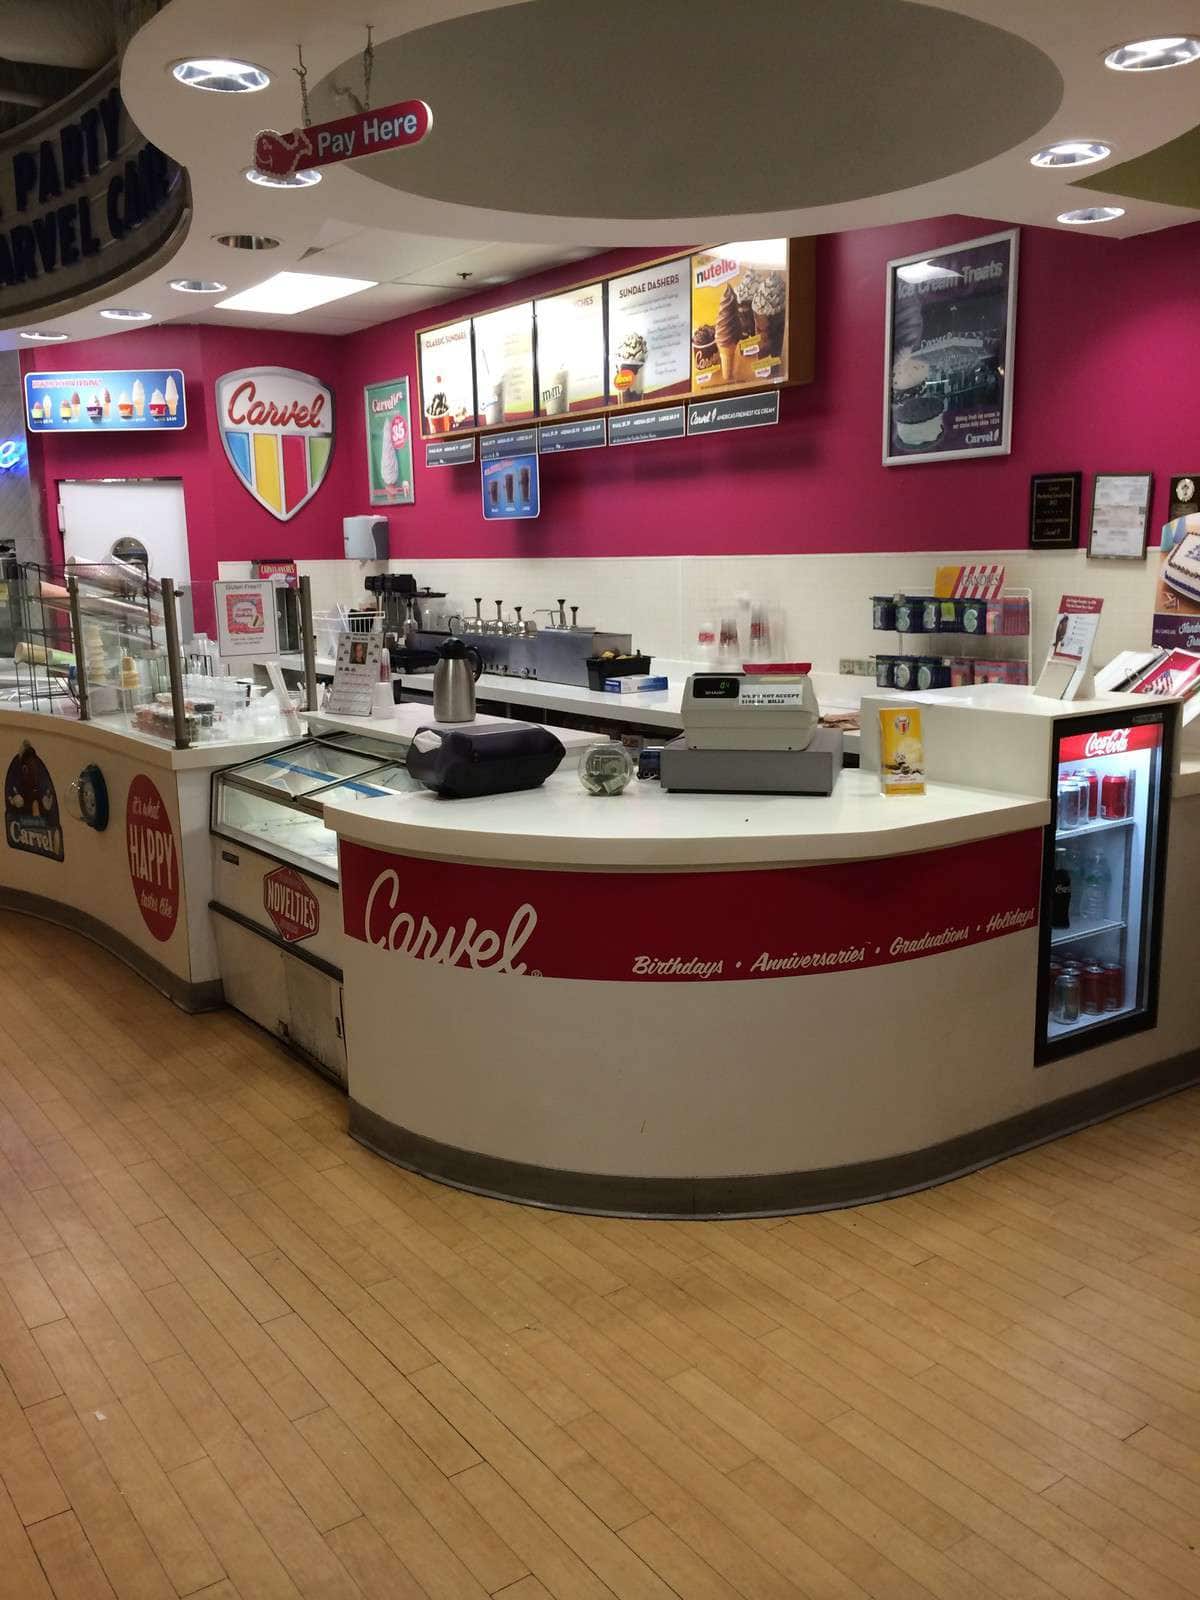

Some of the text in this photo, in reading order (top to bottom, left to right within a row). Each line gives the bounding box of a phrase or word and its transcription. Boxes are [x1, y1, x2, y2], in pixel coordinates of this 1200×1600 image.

[317, 112, 418, 158] Pay Here
[619, 273, 680, 299] SUNDAE DASHERS
[696, 258, 737, 285] nutella
[960, 260, 1005, 287] Treats
[425, 336, 445, 349] CLASSIC
[228, 381, 323, 428] Carvel
[965, 431, 993, 443] Carvel
[1084, 727, 1130, 757] Coca-Cola
[10, 821, 54, 852] Carvel
[129, 823, 174, 890] HAPPY
[267, 878, 316, 931] NOVELTIES
[365, 868, 538, 977] Carvel
[632, 906, 1035, 979] Birthdays Anniversaries Graduations Holidays
